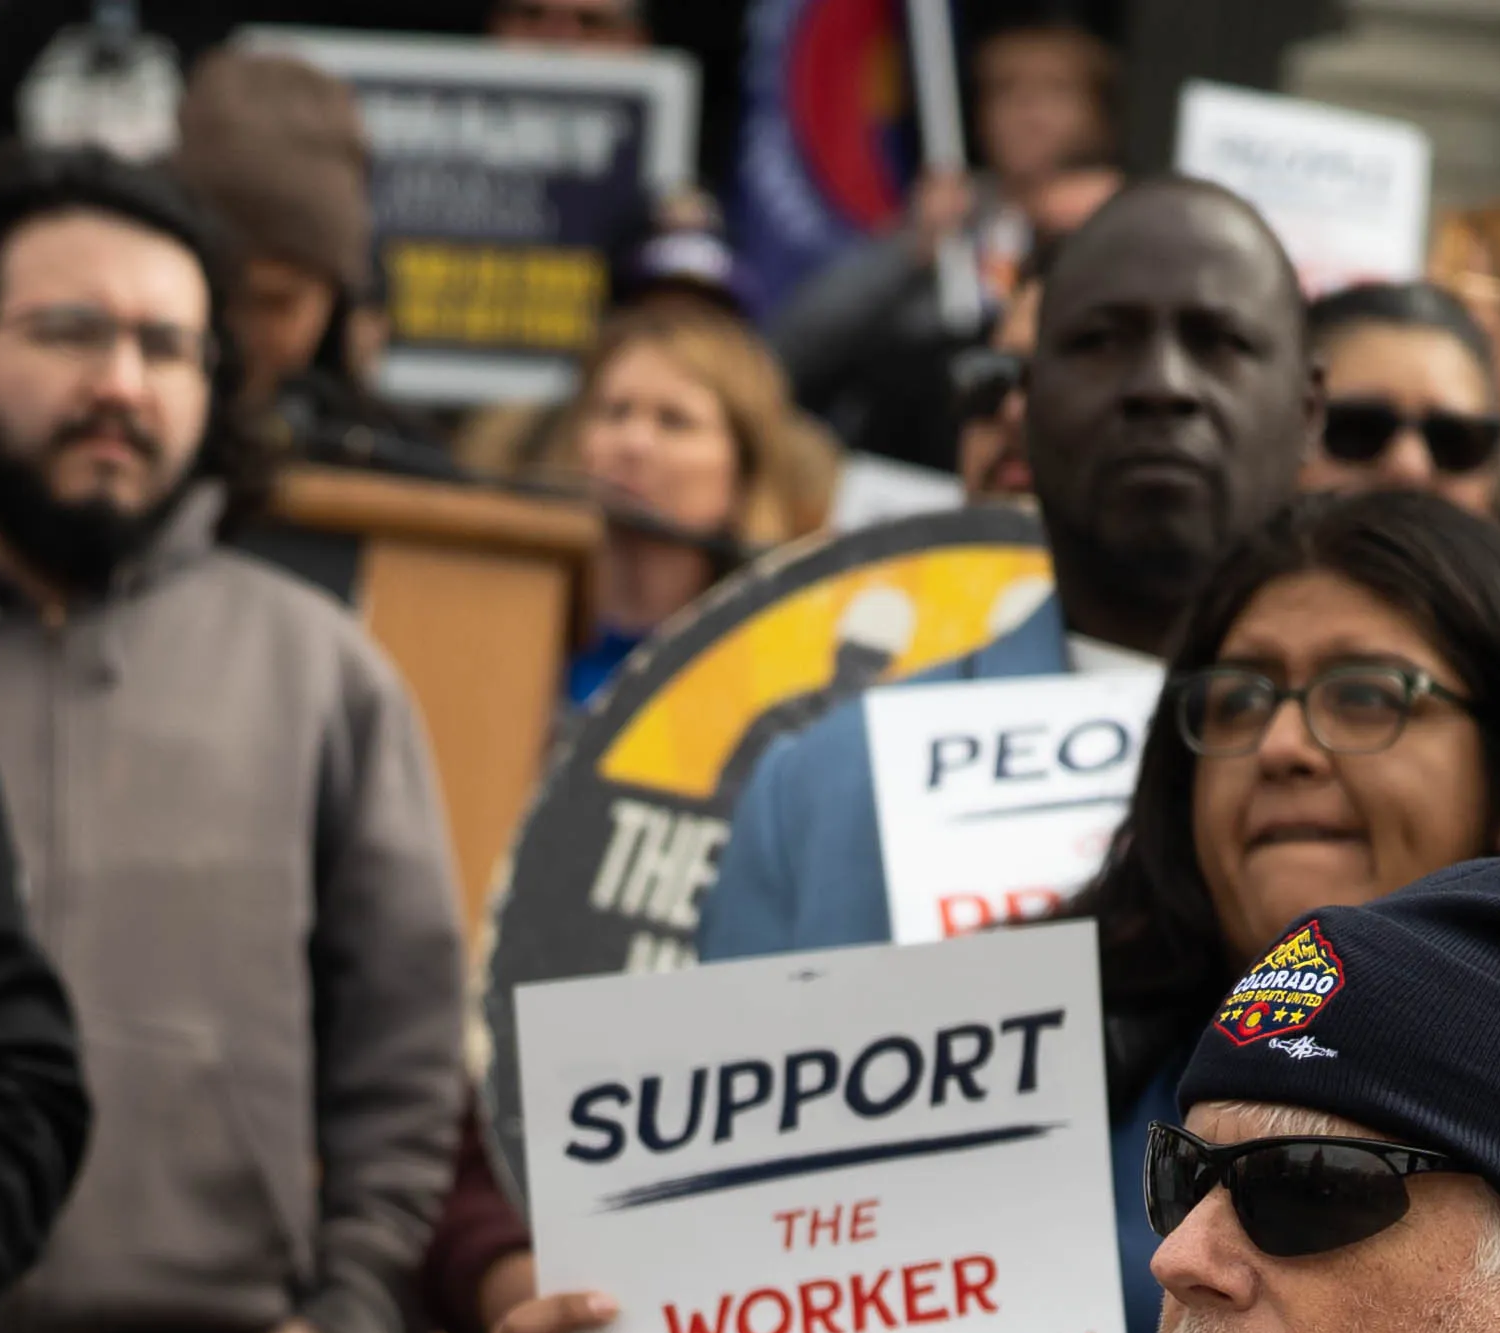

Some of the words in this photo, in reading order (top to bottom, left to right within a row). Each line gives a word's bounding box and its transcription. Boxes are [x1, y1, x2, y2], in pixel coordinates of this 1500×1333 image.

[927, 717, 1134, 794] PEO
[589, 798, 732, 928] THE
[1232, 970, 1334, 994] COLORADO
[1286, 991, 1322, 1007] UNITED
[564, 1008, 1067, 1166] SUPPORT
[773, 1198, 881, 1252] THE
